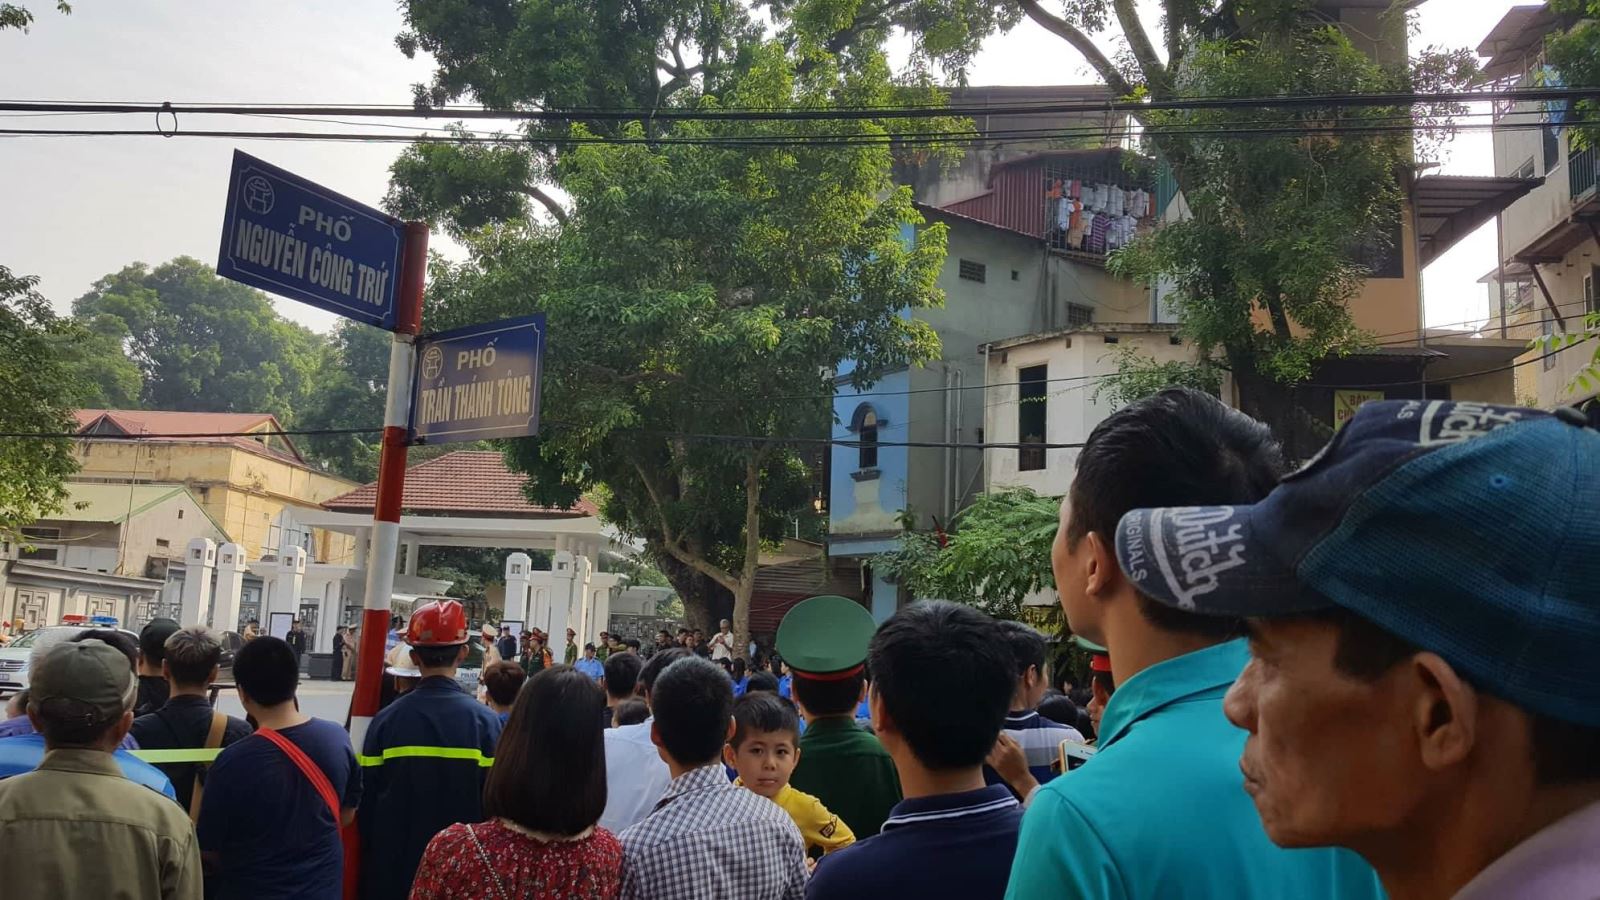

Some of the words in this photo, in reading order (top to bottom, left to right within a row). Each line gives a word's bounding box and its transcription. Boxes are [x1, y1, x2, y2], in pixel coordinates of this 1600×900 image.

[298, 205, 354, 242] PHỐ
[235, 218, 308, 279] NGUYỄN
[309, 243, 354, 296] CÔNG
[356, 261, 389, 306] TRỨ
[457, 337, 498, 370] PHỐ
[421, 376, 453, 424] TRẦN
[454, 374, 495, 420] THÁNH
[497, 369, 532, 416] TÔNG
